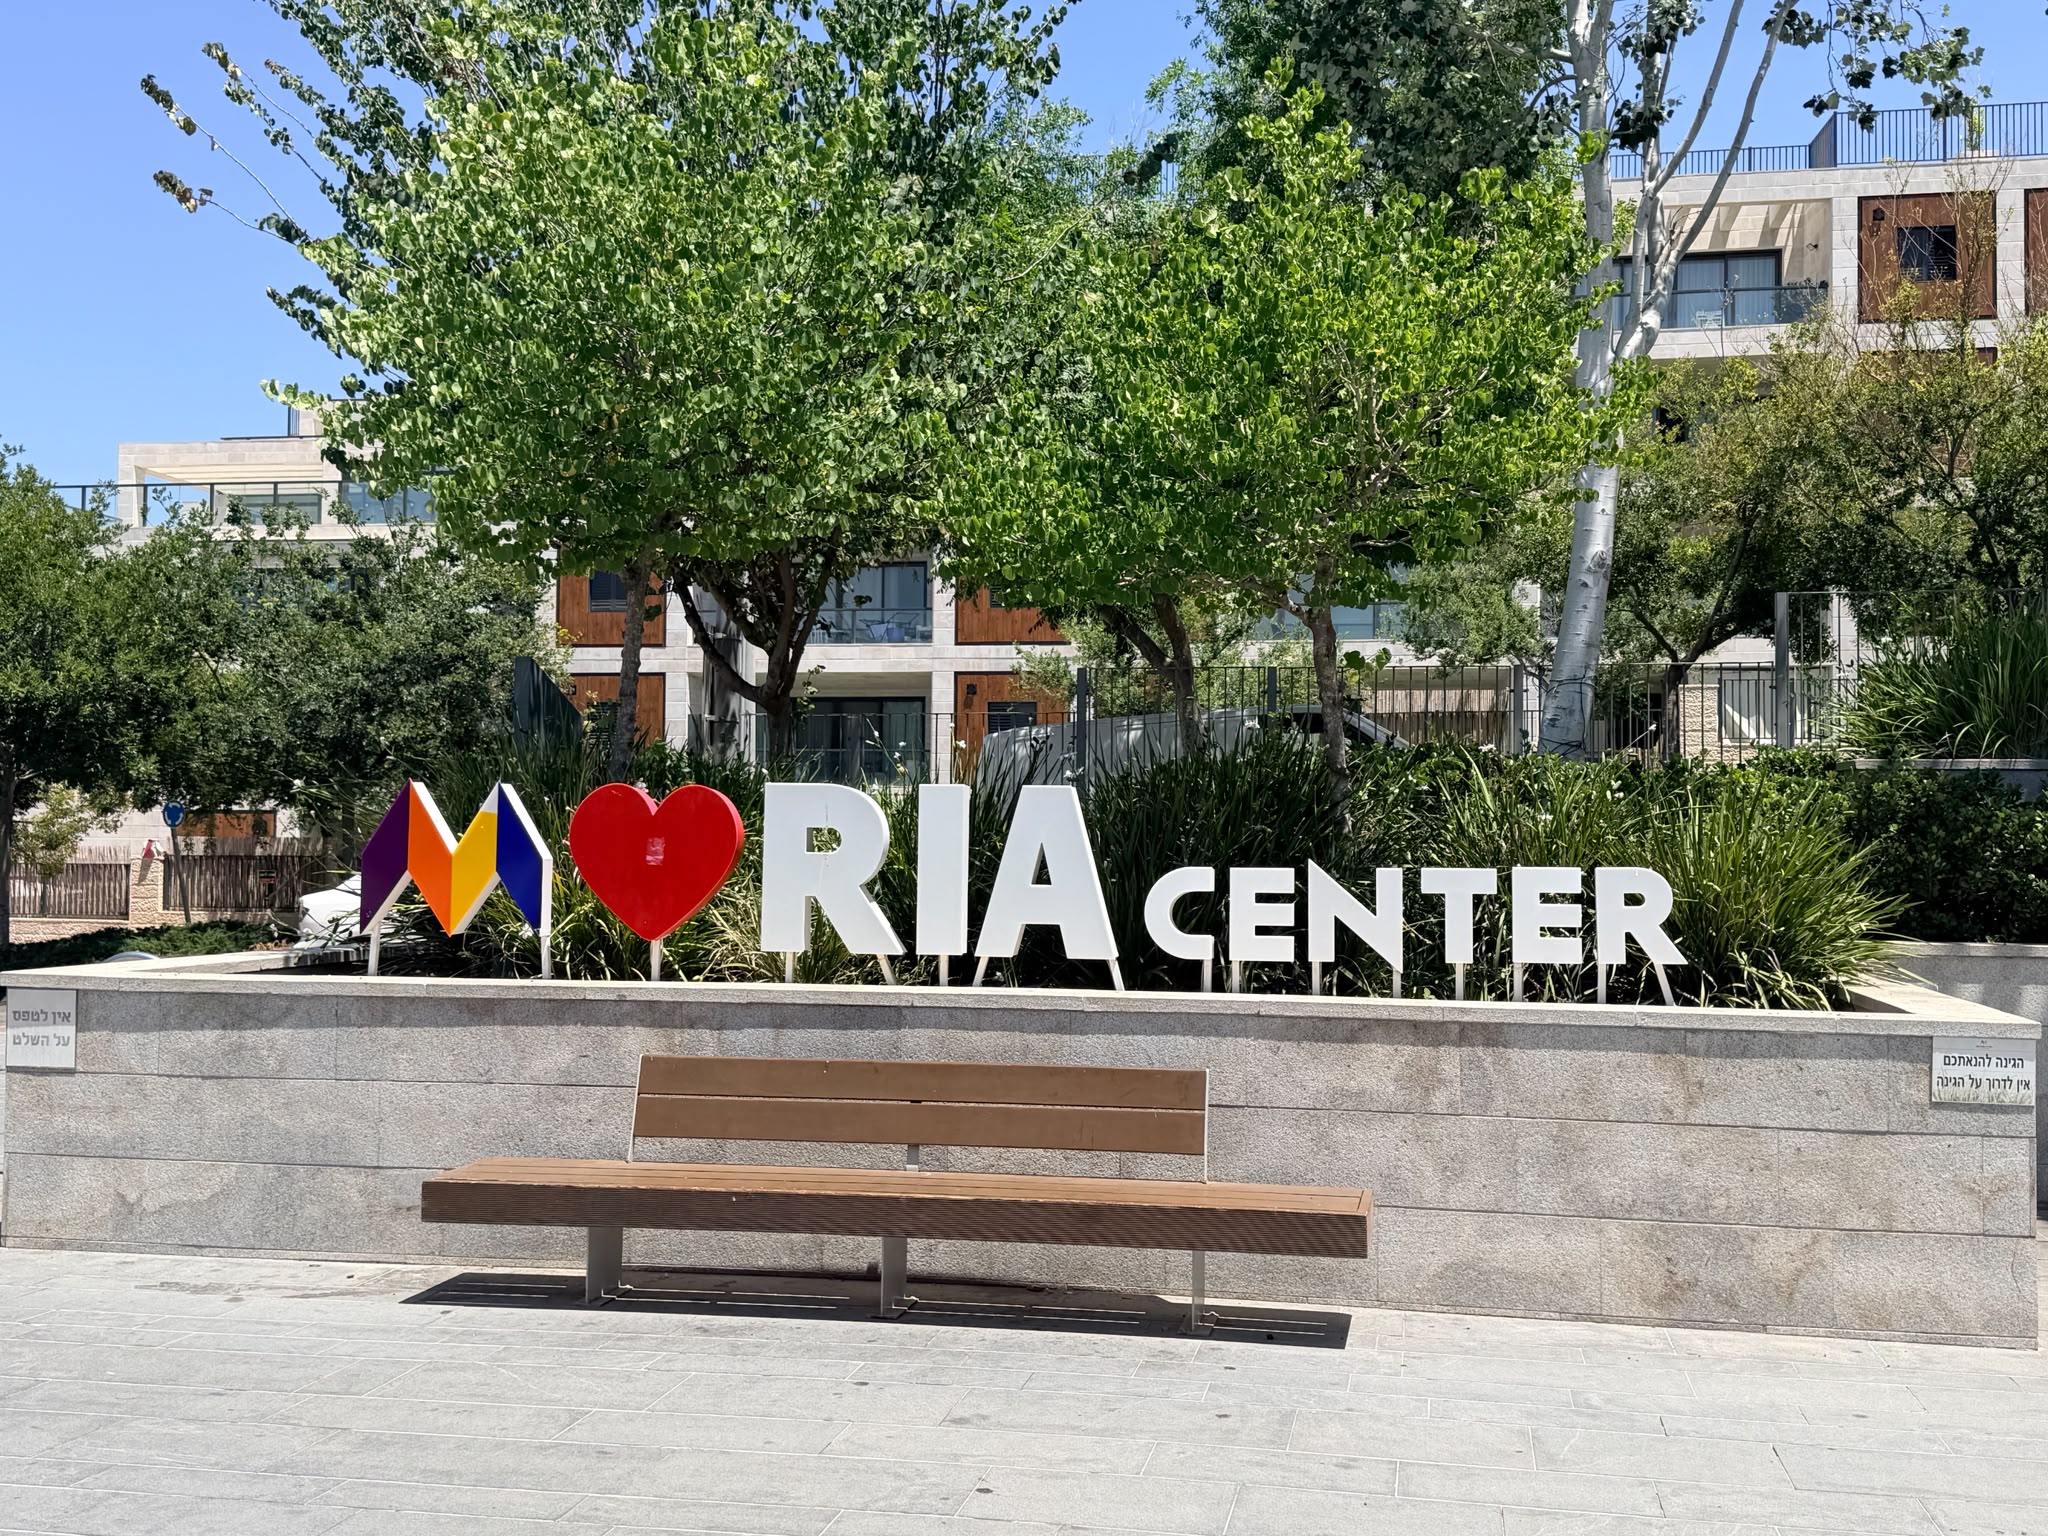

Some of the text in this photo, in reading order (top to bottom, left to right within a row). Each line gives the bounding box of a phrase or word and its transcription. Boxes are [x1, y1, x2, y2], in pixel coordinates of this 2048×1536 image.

[1144, 858, 1688, 973] CENTER
[12, 1008, 71, 1025] אין לטפס
[12, 1032, 70, 1047] על השלט
[1943, 1053, 2025, 1069] הגינה להנאתכם
[1936, 1074, 2031, 1093] אין לדרוך על הגינה
